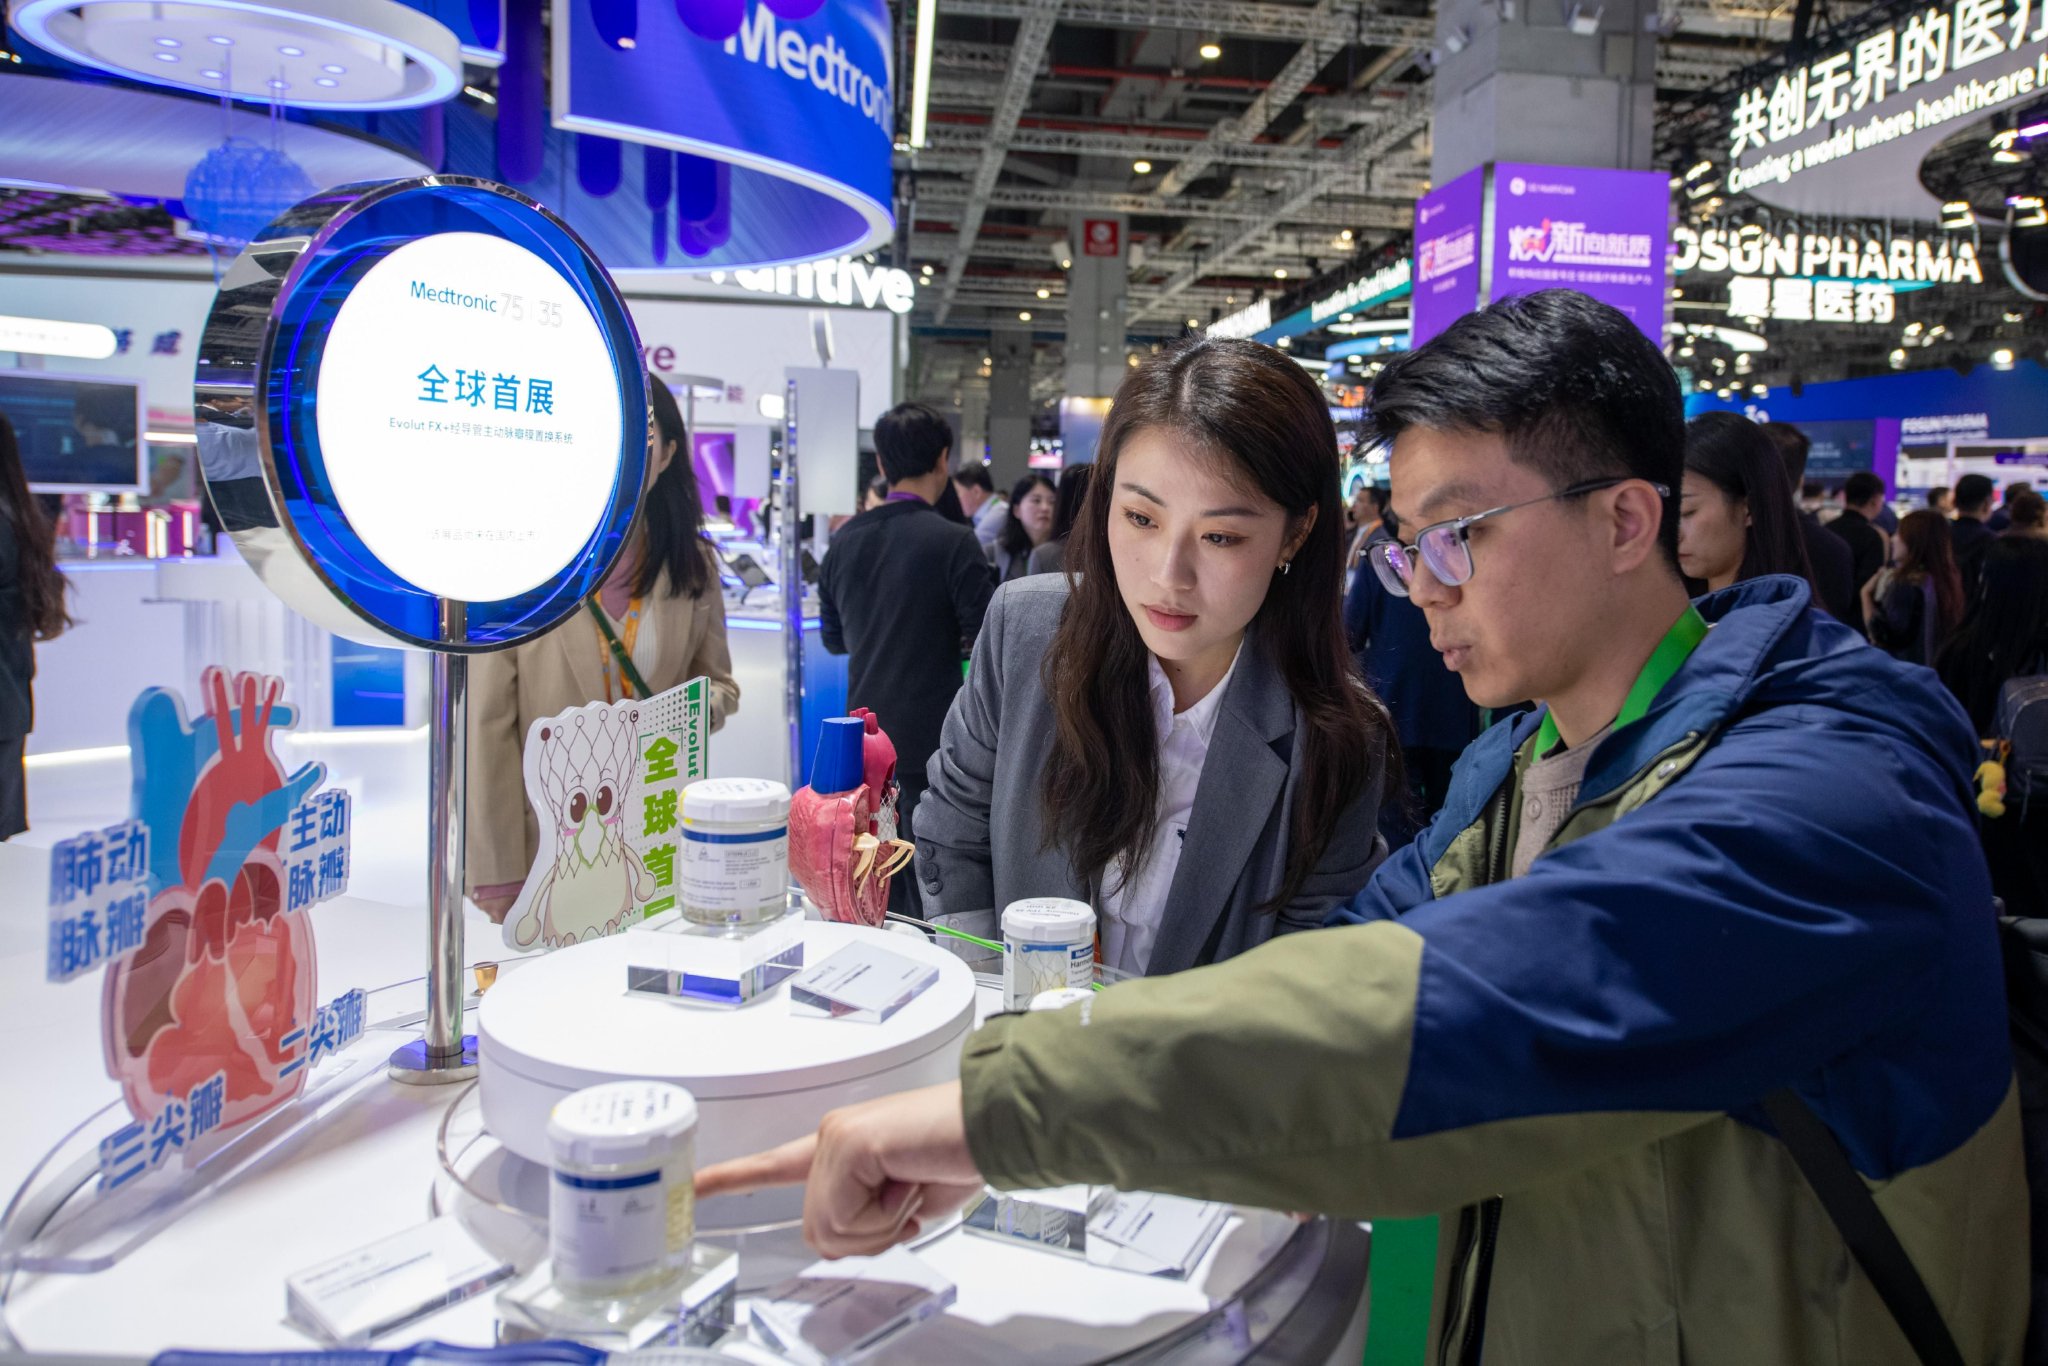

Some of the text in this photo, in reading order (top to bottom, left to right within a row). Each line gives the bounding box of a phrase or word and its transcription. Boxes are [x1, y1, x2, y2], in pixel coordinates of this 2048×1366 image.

[1728, 66, 2035, 194] Creating a world where healthcare
[711, 255, 914, 313] antive
[1672, 226, 1983, 283] OSUN PHARMA
[411, 280, 497, 312] Medtronic
[1727, 276, 1895, 323] 复星医药
[417, 364, 554, 416] 全球首展
[389, 417, 425, 431] Evolut
[688, 700, 700, 778] Evolut
[289, 794, 346, 852] 主动
[61, 827, 147, 902] 肺动
[287, 847, 346, 912] 脉瓣
[60, 896, 146, 979] 脉瓣
[279, 993, 364, 1078] 二尖瓣
[106, 1076, 224, 1190] 三尖瓣
